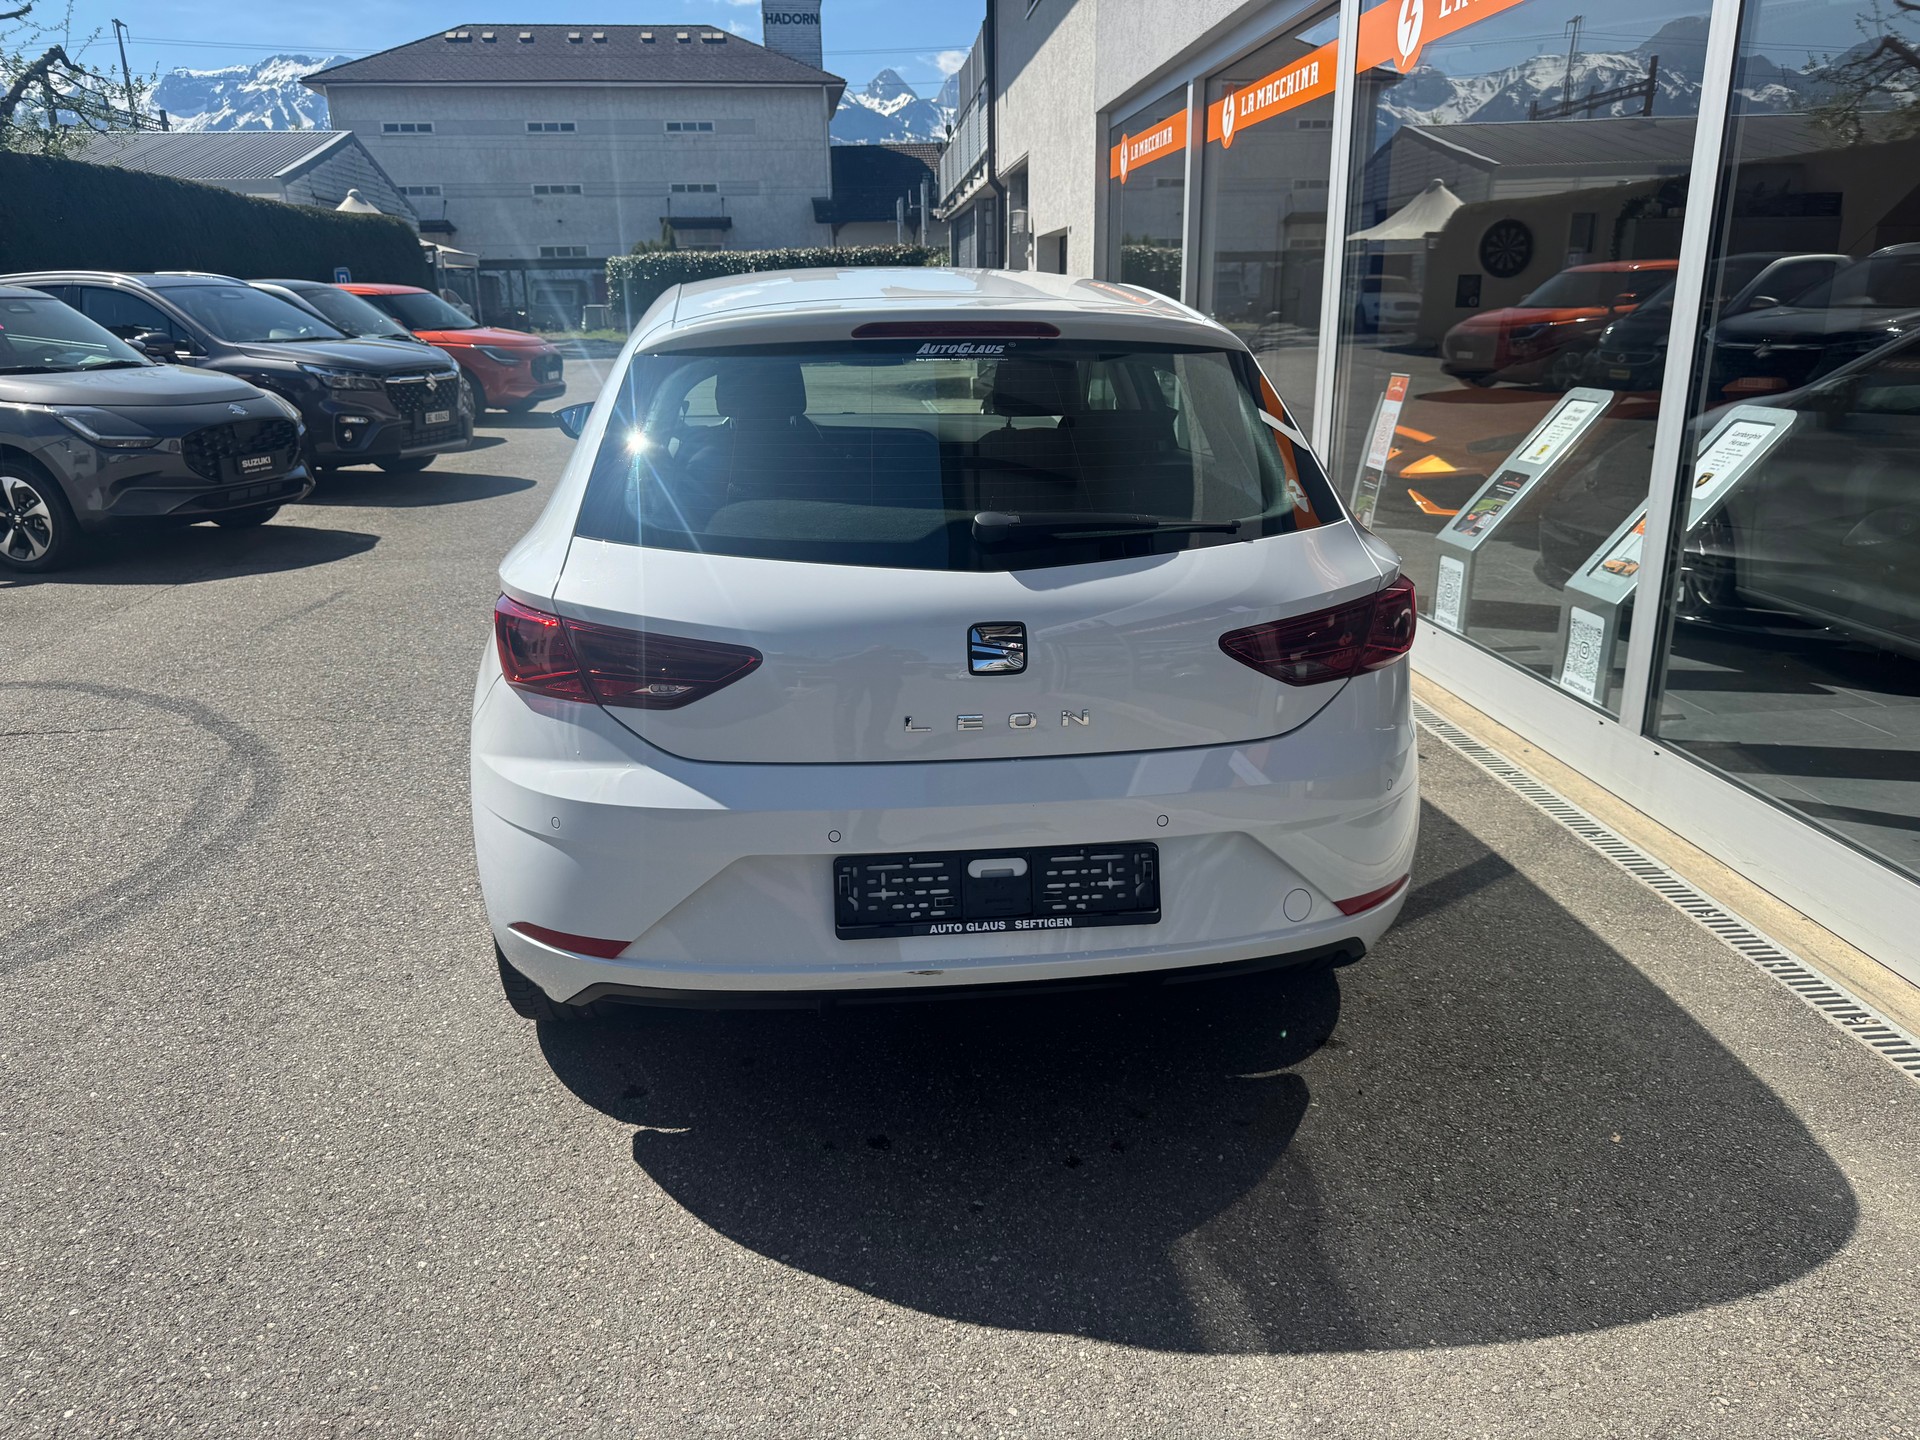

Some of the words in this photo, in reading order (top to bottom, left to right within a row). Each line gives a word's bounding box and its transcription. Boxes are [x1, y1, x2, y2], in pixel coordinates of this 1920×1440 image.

[765, 12, 819, 25] HADORN
[1241, 92, 1254, 117] LA
[1256, 61, 1319, 110] MACCHINA
[242, 456, 271, 468] SUZUKI
[904, 709, 1090, 732] LEON
[929, 923, 963, 934] AUTO
[966, 921, 1006, 932] GLAUS
[1014, 918, 1073, 929] SEFTIGEN
